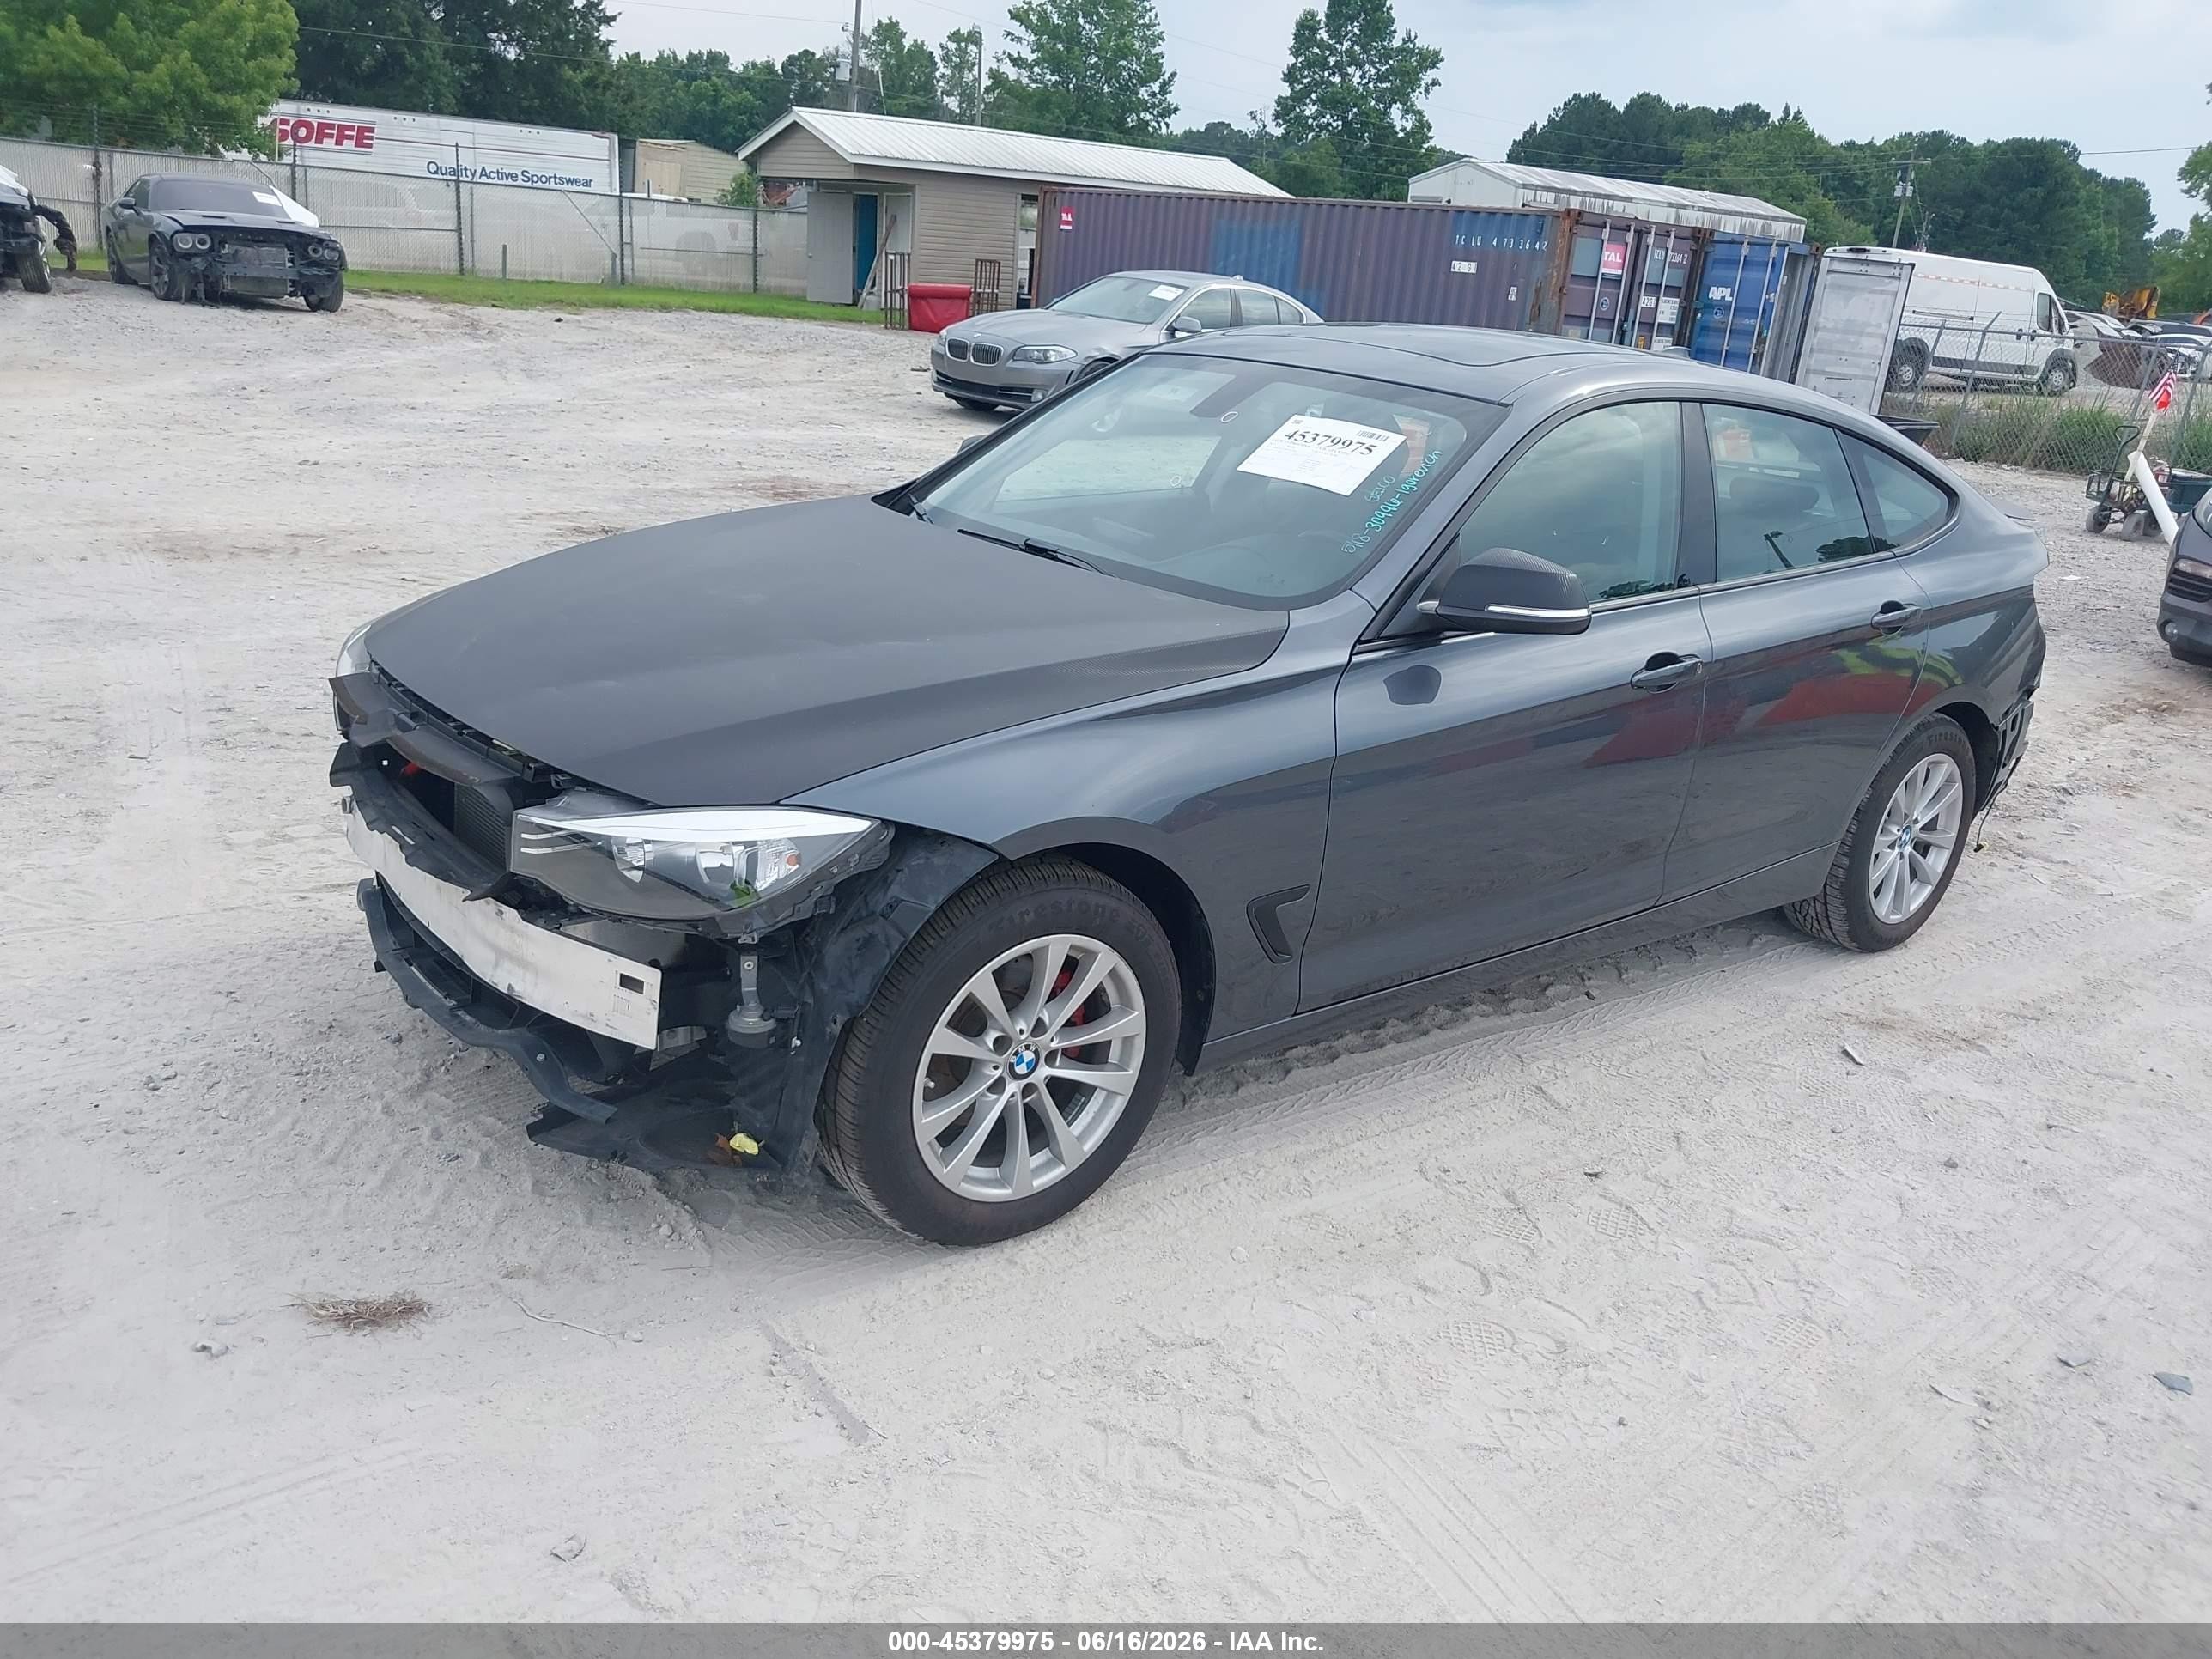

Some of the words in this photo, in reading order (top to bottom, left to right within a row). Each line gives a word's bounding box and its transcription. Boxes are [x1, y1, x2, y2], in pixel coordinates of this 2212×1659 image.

[276, 118, 375, 149] SOFFE
[427, 161, 477, 180] Quality
[479, 167, 519, 182] Active
[520, 170, 592, 188] Sportswear
[1604, 251, 1622, 263] TAL
[1709, 287, 1733, 301] APL
[1285, 430, 1377, 455] 45379975
[1010, 1044, 1036, 1062] BMW
